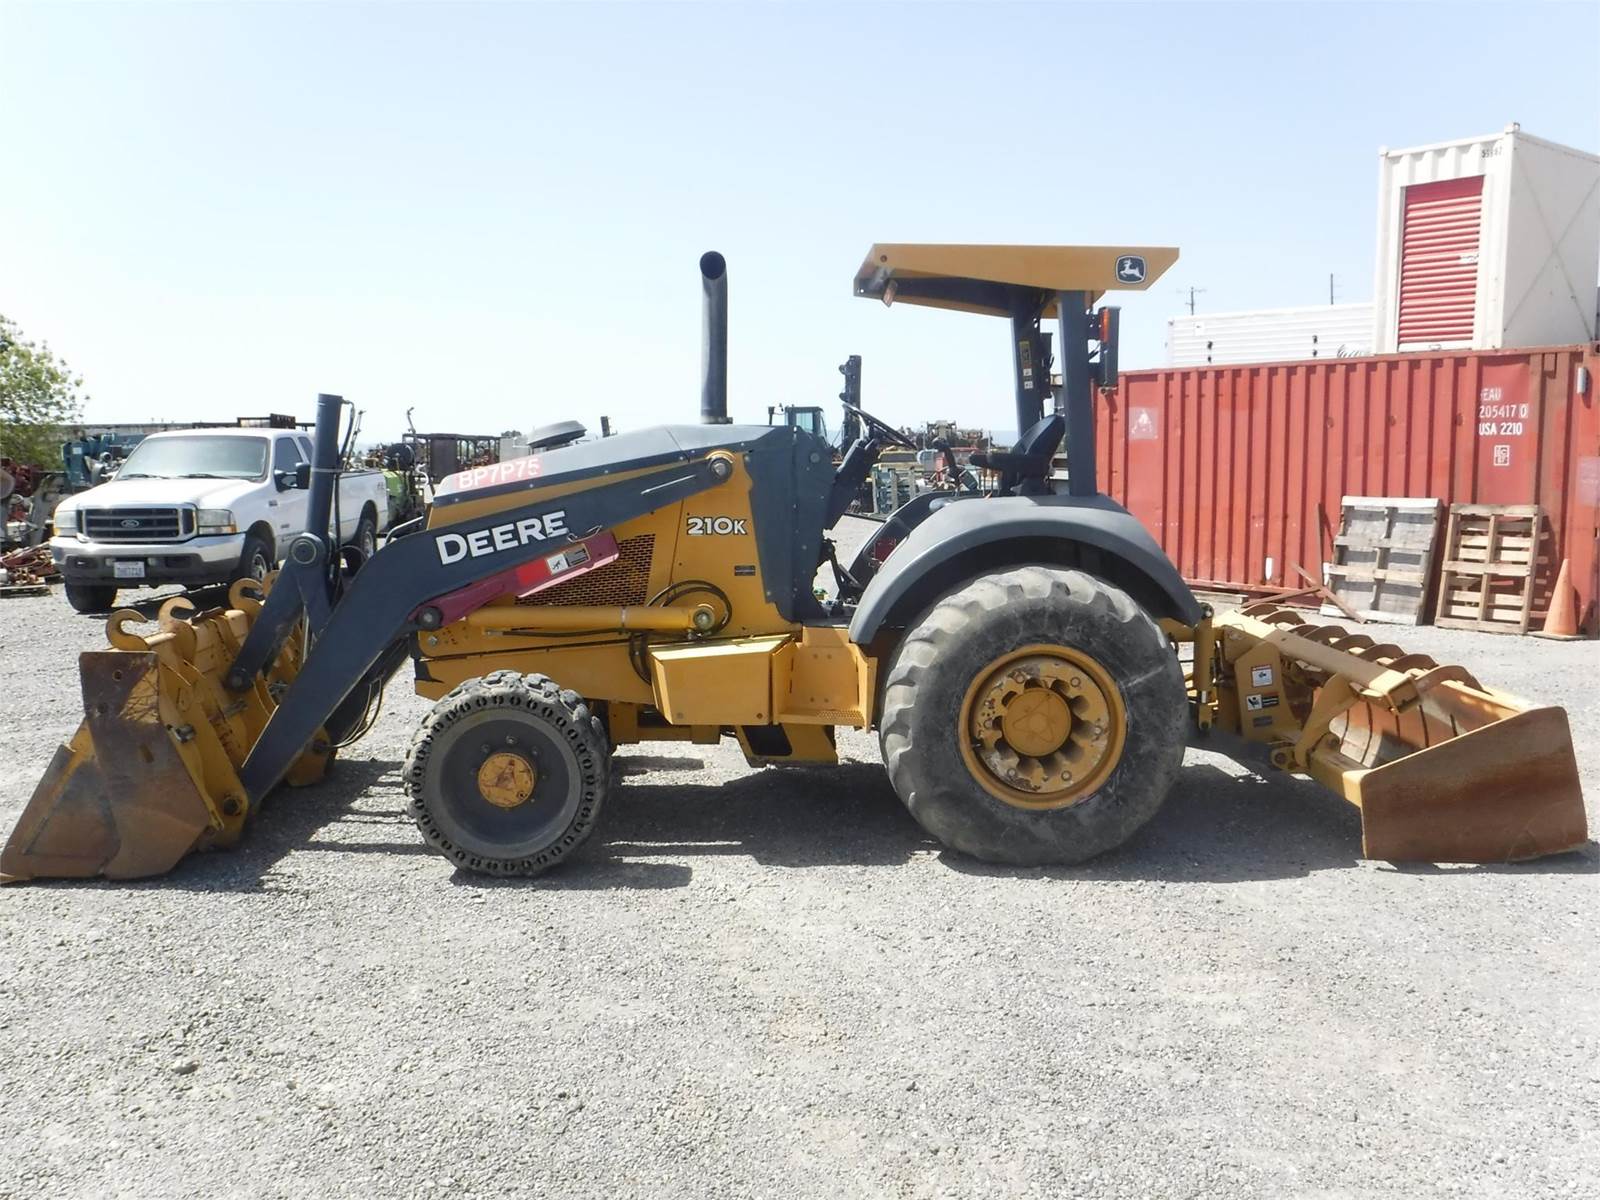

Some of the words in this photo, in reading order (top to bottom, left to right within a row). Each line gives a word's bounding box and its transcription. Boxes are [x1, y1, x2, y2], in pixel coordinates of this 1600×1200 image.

[1480, 388, 1502, 401] EAU
[1479, 404, 1517, 418] 205417
[1519, 403, 1529, 419] 0
[1479, 422, 1497, 436] USA
[1500, 422, 1523, 436] 2210
[458, 458, 540, 489] BP7P75
[687, 516, 747, 535] 210K
[435, 510, 569, 565] DEERE
